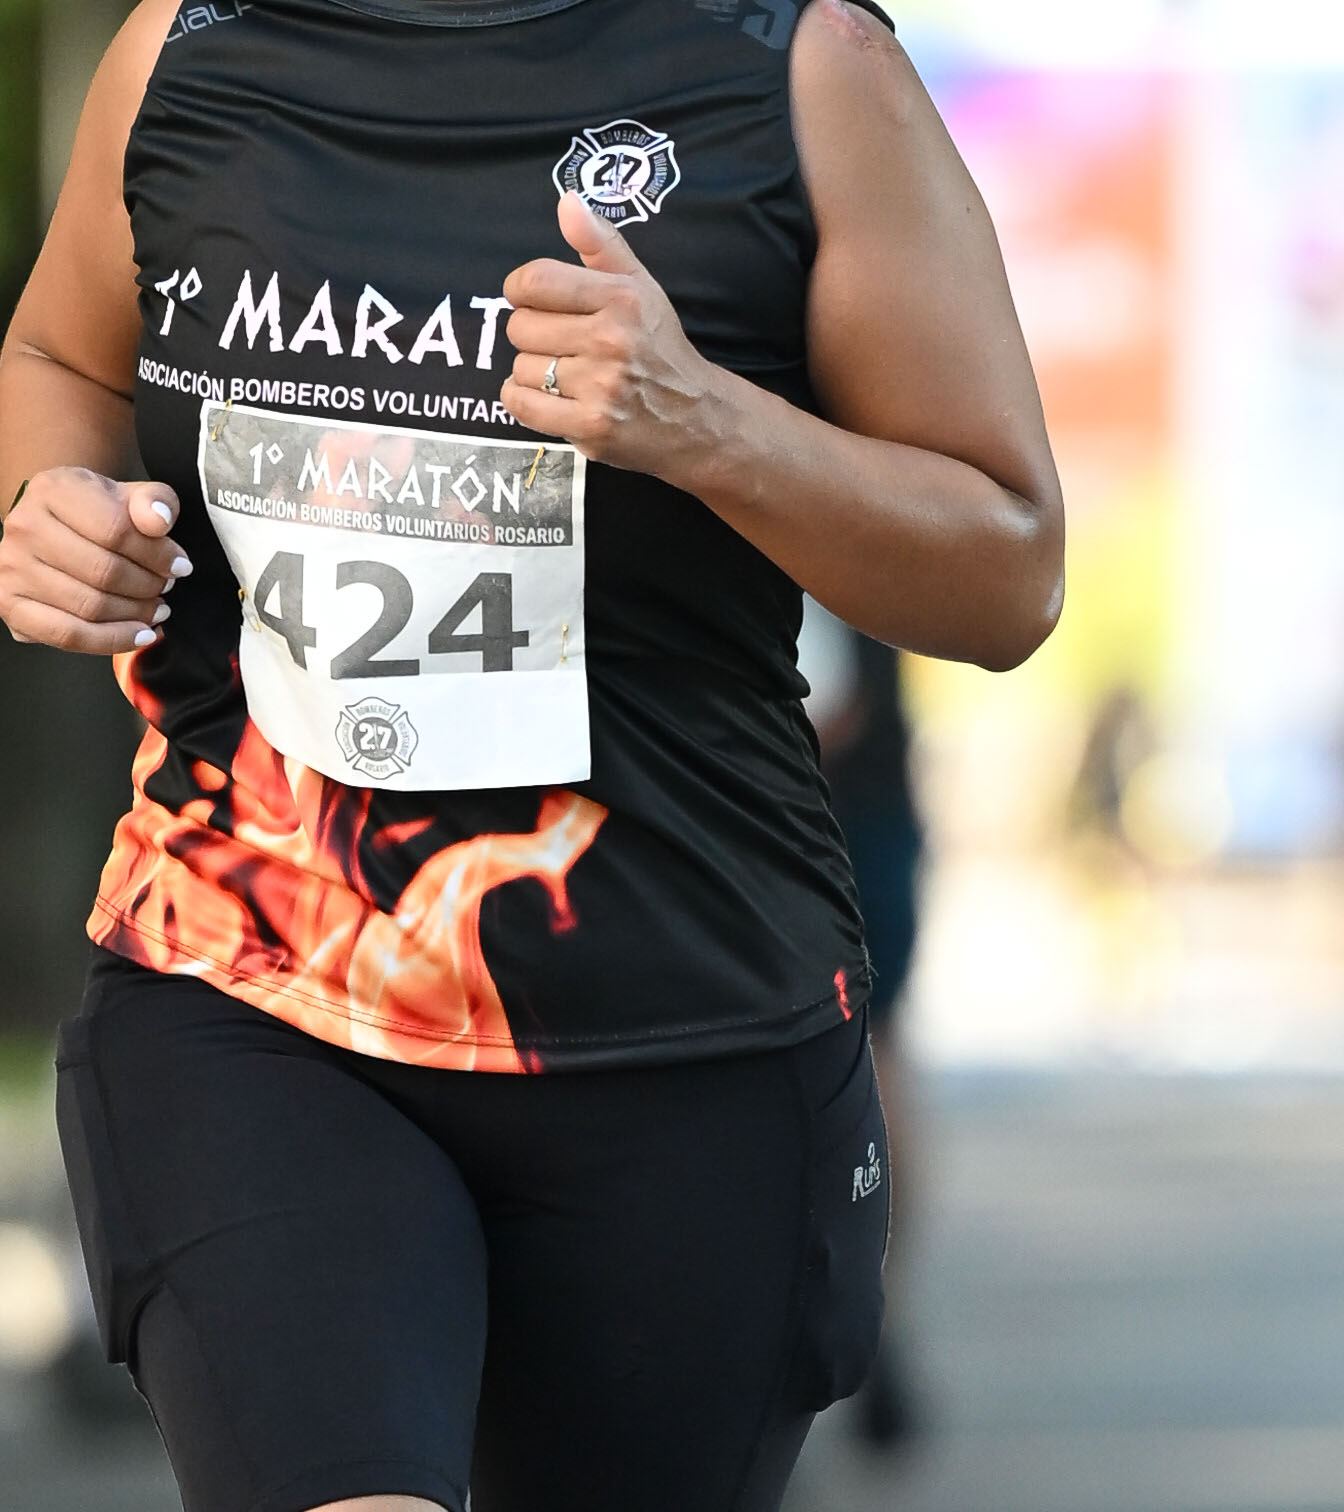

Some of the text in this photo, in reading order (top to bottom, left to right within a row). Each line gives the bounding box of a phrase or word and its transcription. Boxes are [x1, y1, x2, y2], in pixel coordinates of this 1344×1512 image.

[592, 152, 644, 187] 27
[137, 356, 225, 402] ASOCIACIÓN
[230, 377, 366, 411] BOMBEROS
[296, 447, 522, 515] MARATÓN
[216, 487, 567, 545] ASOCIACIÓN BOMBEROS VOLUNTARIOS ROSARIO
[253, 550, 531, 681] 424
[358, 721, 393, 752] 27
